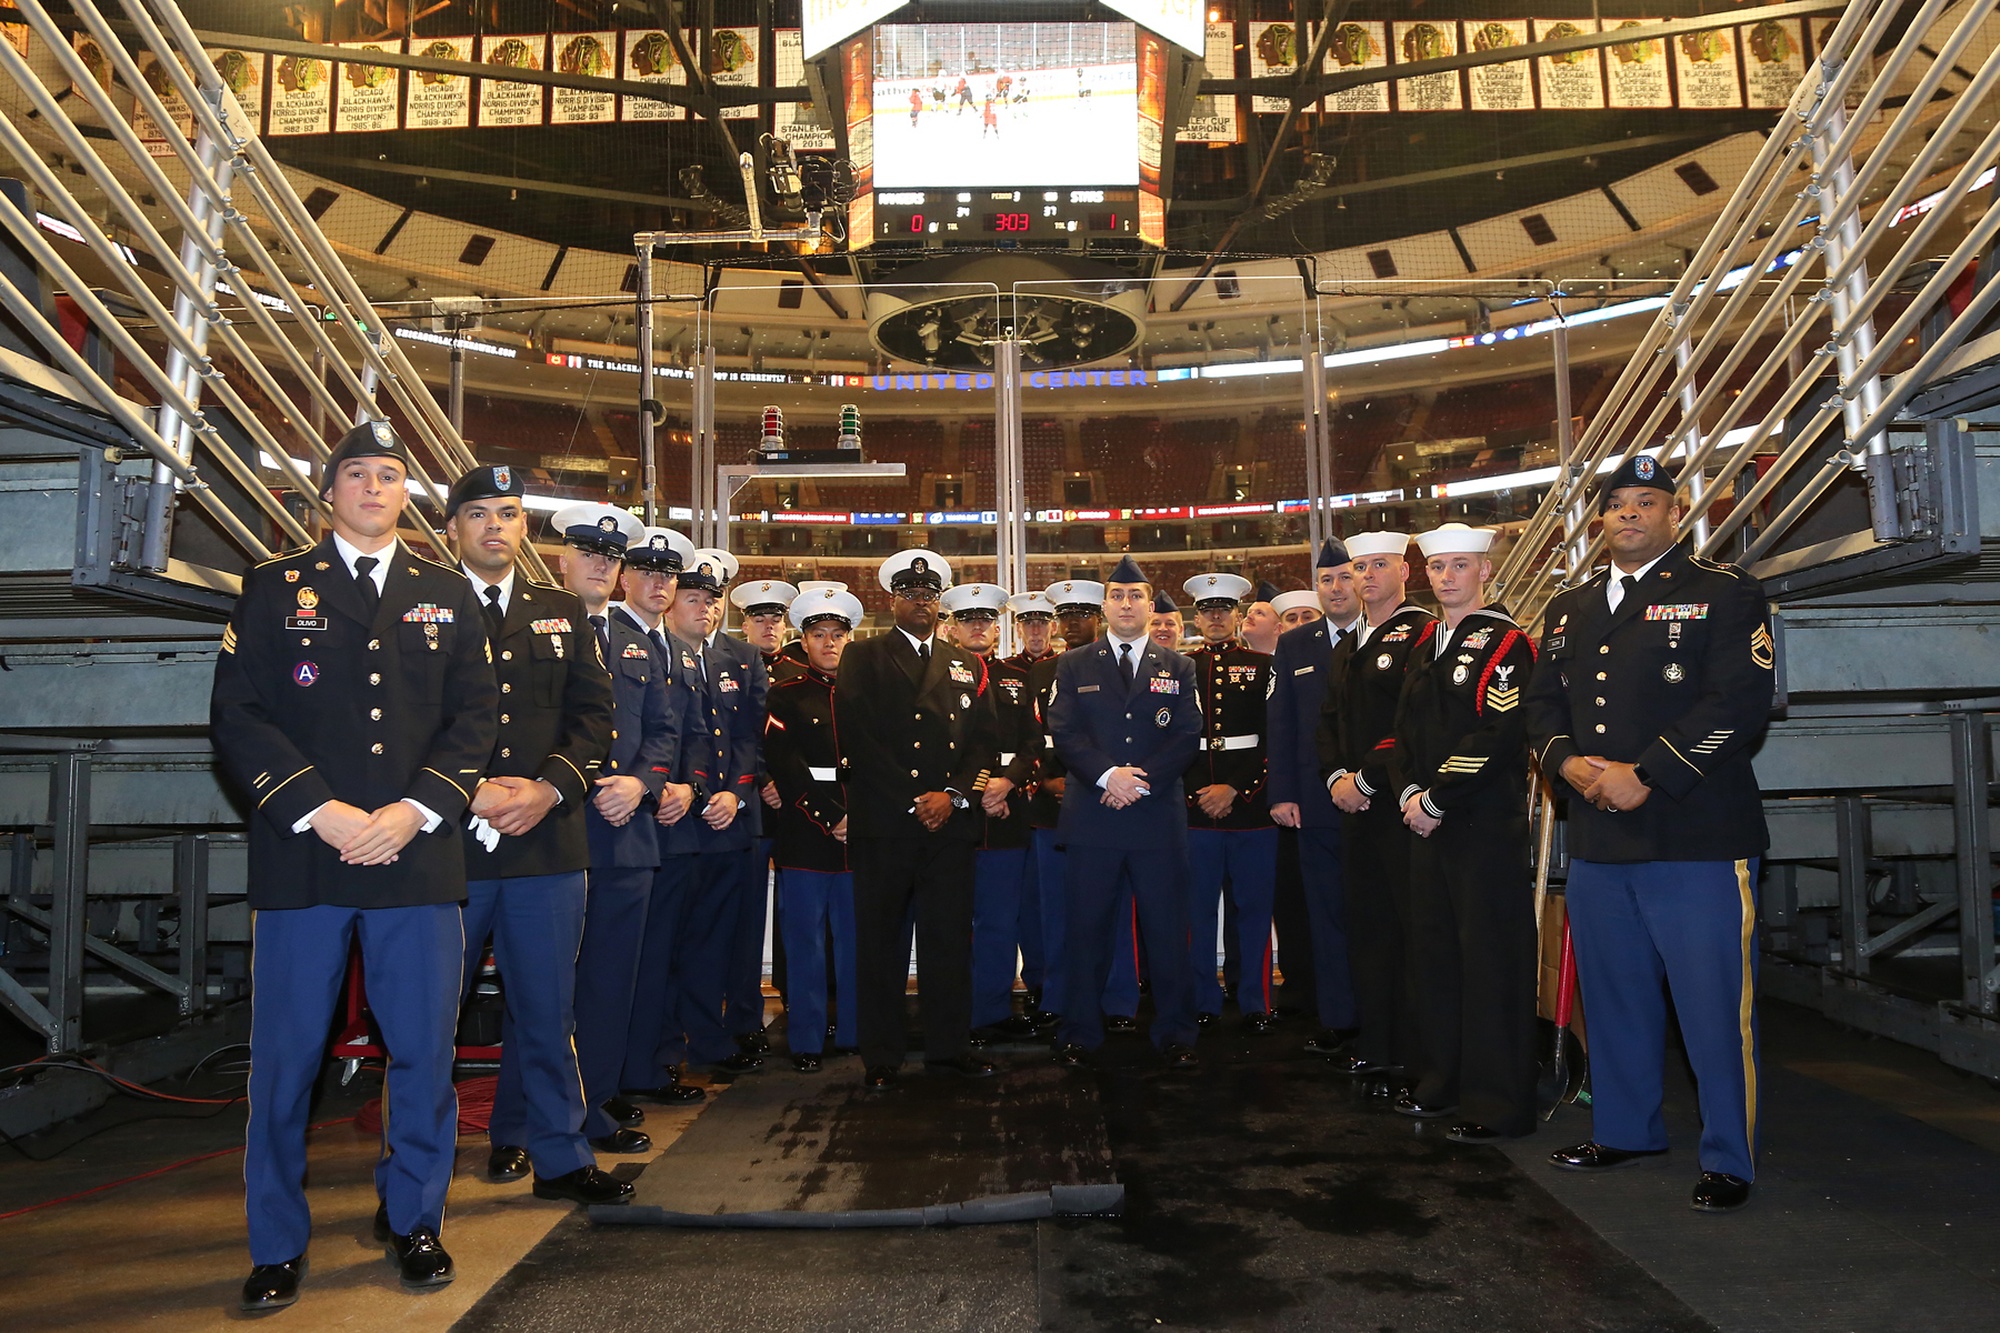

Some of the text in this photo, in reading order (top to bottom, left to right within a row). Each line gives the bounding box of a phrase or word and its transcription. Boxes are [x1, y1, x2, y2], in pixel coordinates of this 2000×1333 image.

[1485, 65, 1515, 73] CHICAGO
[1477, 72, 1524, 80] BLACKHAWKS
[1615, 70, 1662, 78] BLACKHAWKS
[496, 83, 527, 91] CHICAGO
[285, 92, 315, 100] CHICAGO
[353, 89, 384, 97] CHICAGO
[414, 93, 462, 101] BLACKHAWKS
[487, 91, 536, 99] BLACKHAWKS
[343, 97, 390, 105] BLACKHAWKS
[510, 99, 540, 107] DIVISION
[555, 95, 613, 104] NORRIS DIVISION
[1337, 96, 1378, 104] CHAMPIONS
[276, 100, 323, 108] BLACKHAWKS
[340, 103, 395, 113] NORRIS DIVISION
[410, 100, 466, 110] NORRIS DIVISION
[273, 107, 327, 117] NORRIS DIVISION
[489, 108, 531, 116] CHAMPIONS
[563, 104, 605, 113] CHAMPIONS
[346, 114, 386, 122] CHAMPIONS
[417, 110, 458, 118] CHAMPIONS
[633, 110, 675, 119] 2009-2010
[279, 116, 319, 125] CHAMPIONS
[1211, 117, 1230, 125] CUP
[781, 125, 821, 133] STANLEY
[1184, 125, 1227, 133] AMPIONS
[785, 132, 834, 141] CHAMPION
[1187, 132, 1210, 140] 1934
[803, 140, 824, 148] 2013
[1070, 190, 1104, 203] STARS
[911, 214, 924, 232] 0
[995, 213, 1030, 232] 3:03
[1110, 213, 1117, 230] 1
[587, 359, 605, 369] THE
[740, 373, 786, 383] CURRENTLY
[872, 370, 1148, 392] UNITED CENTER
[296, 619, 317, 627] OLIVO
[298, 664, 314, 681] A
